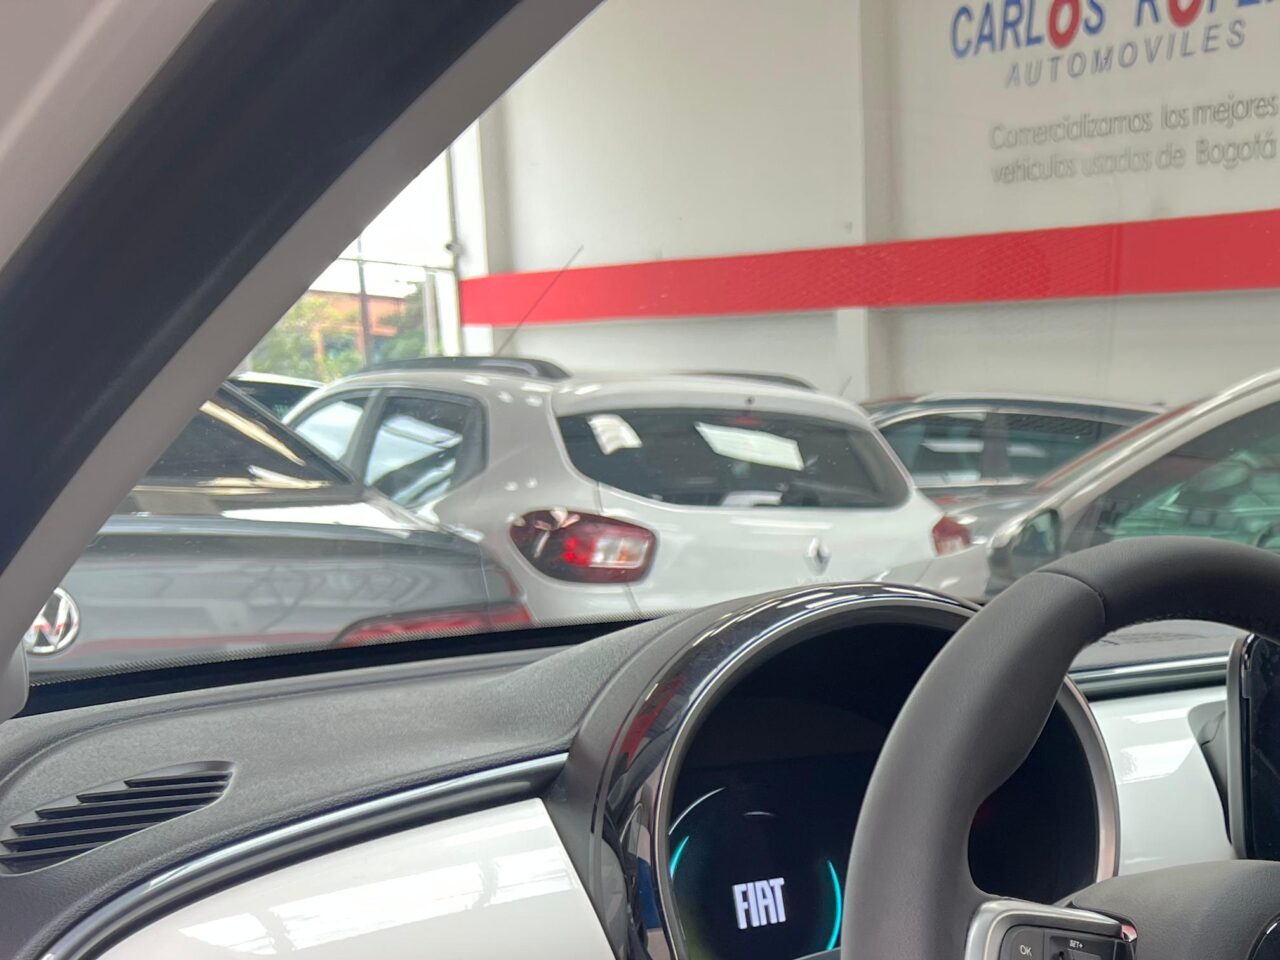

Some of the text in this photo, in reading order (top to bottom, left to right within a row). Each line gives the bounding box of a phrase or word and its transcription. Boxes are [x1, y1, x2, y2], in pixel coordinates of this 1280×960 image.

[952, 0, 1106, 59] CARLOS
[1006, 19, 1246, 88] AUTOMOVILES
[1160, 103, 1190, 130] los
[1192, 94, 1279, 129] mejores
[1155, 143, 1187, 170] de
[1195, 131, 1277, 170] Bogotá
[732, 877, 786, 930] FIAT
[1020, 944, 1032, 957] OK
